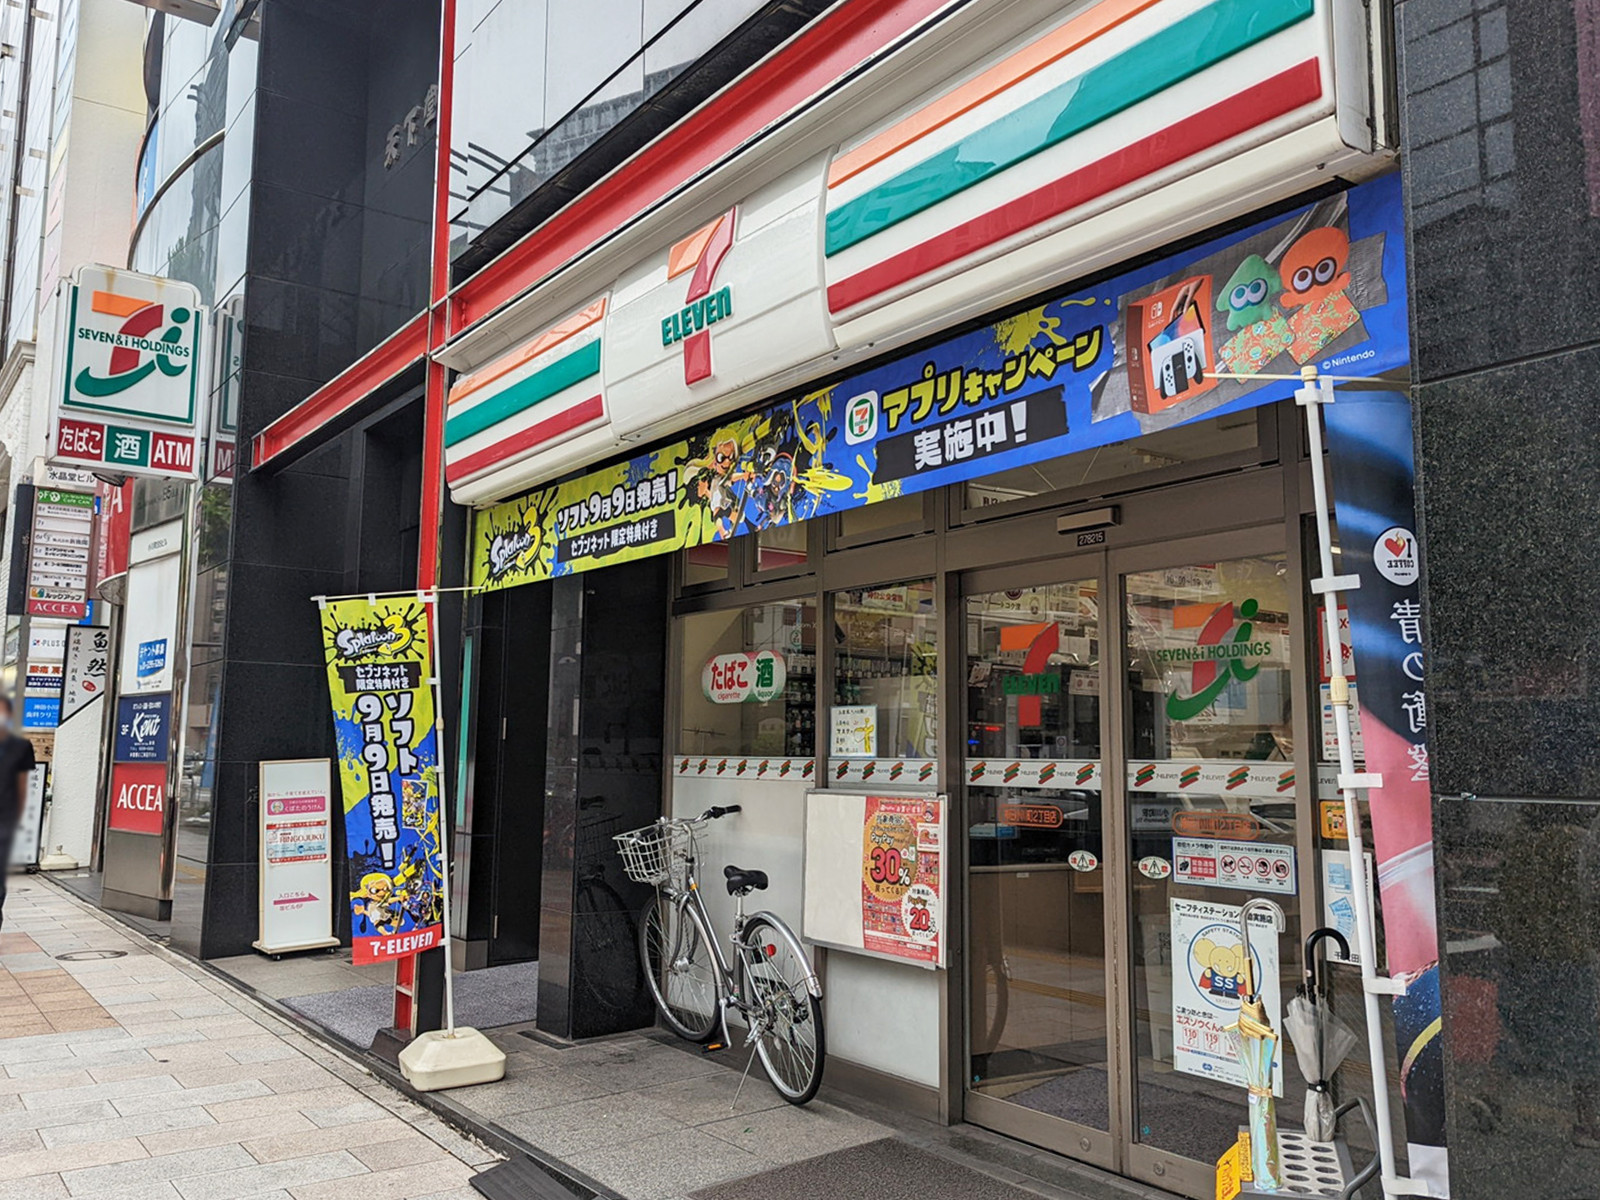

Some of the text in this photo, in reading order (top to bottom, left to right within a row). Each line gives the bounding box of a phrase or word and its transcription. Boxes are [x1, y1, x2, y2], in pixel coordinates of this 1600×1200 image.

[131, 337, 190, 358] HOLDINGS
[1332, 350, 1376, 368] Nintendo
[883, 328, 1101, 430] アプリキャンペーン
[60, 425, 102, 455] たばこ
[114, 432, 142, 461] 酒
[914, 400, 1028, 471] 実施中!
[153, 440, 191, 467] ATM
[557, 471, 677, 533] ソフト9月9日発売!
[571, 519, 658, 556] セブンネット 限定特典付き
[34, 603, 77, 614] ACCEA
[336, 629, 396, 656] Splatoon
[1207, 642, 1271, 659] HOLDINGS
[355, 665, 408, 679] セブンネット
[356, 677, 410, 691] 限定特典付き
[711, 660, 748, 690] たばこ
[755, 658, 774, 688] 酒
[717, 691, 741, 701] cigarette
[384, 692, 419, 775] ソフト
[356, 693, 399, 868] 9月9日発売!
[116, 783, 163, 812] ACCEA
[870, 832, 894, 847] PayPay
[1214, 976, 1234, 989] SS
[1183, 1028, 1197, 1039] 110
[1205, 1033, 1219, 1044] 119
